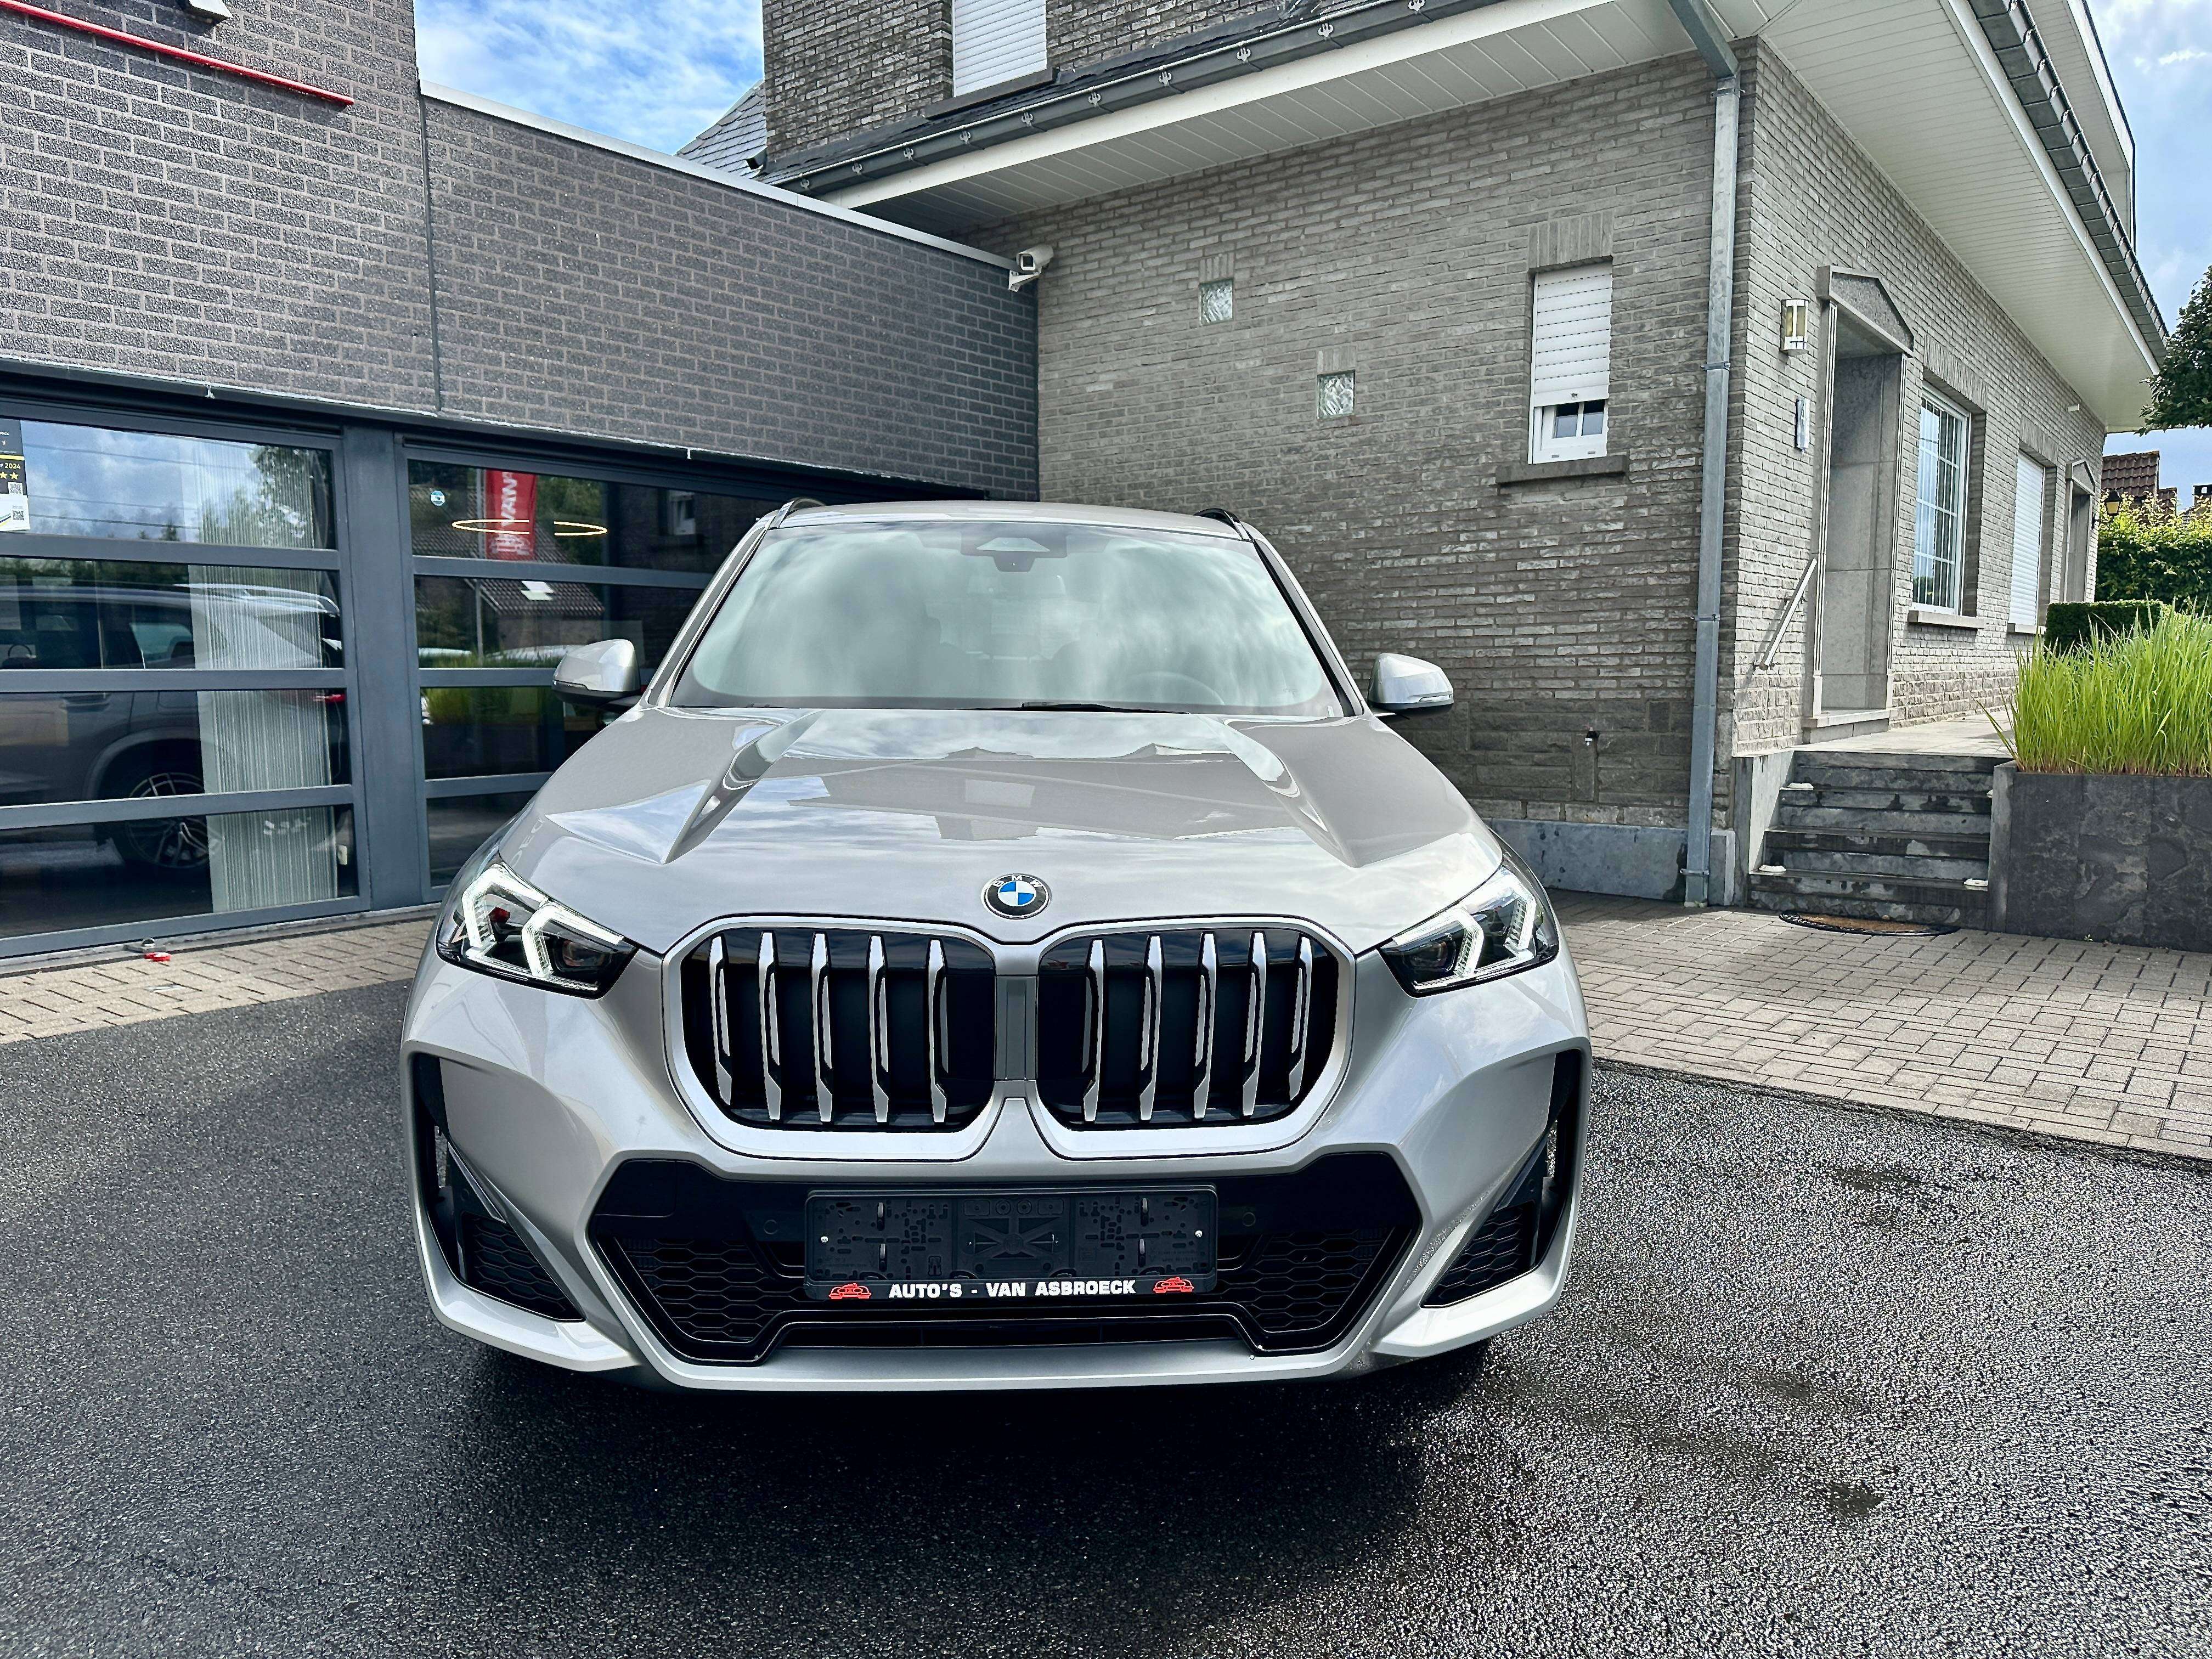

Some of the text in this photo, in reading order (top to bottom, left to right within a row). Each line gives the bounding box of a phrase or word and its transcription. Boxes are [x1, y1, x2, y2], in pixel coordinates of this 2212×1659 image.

[992, 874, 1043, 888] BMW
[888, 1283, 962, 1299] AUTO'S
[985, 1282, 1026, 1297] VAN
[1035, 1279, 1136, 1296] ASBROECK
